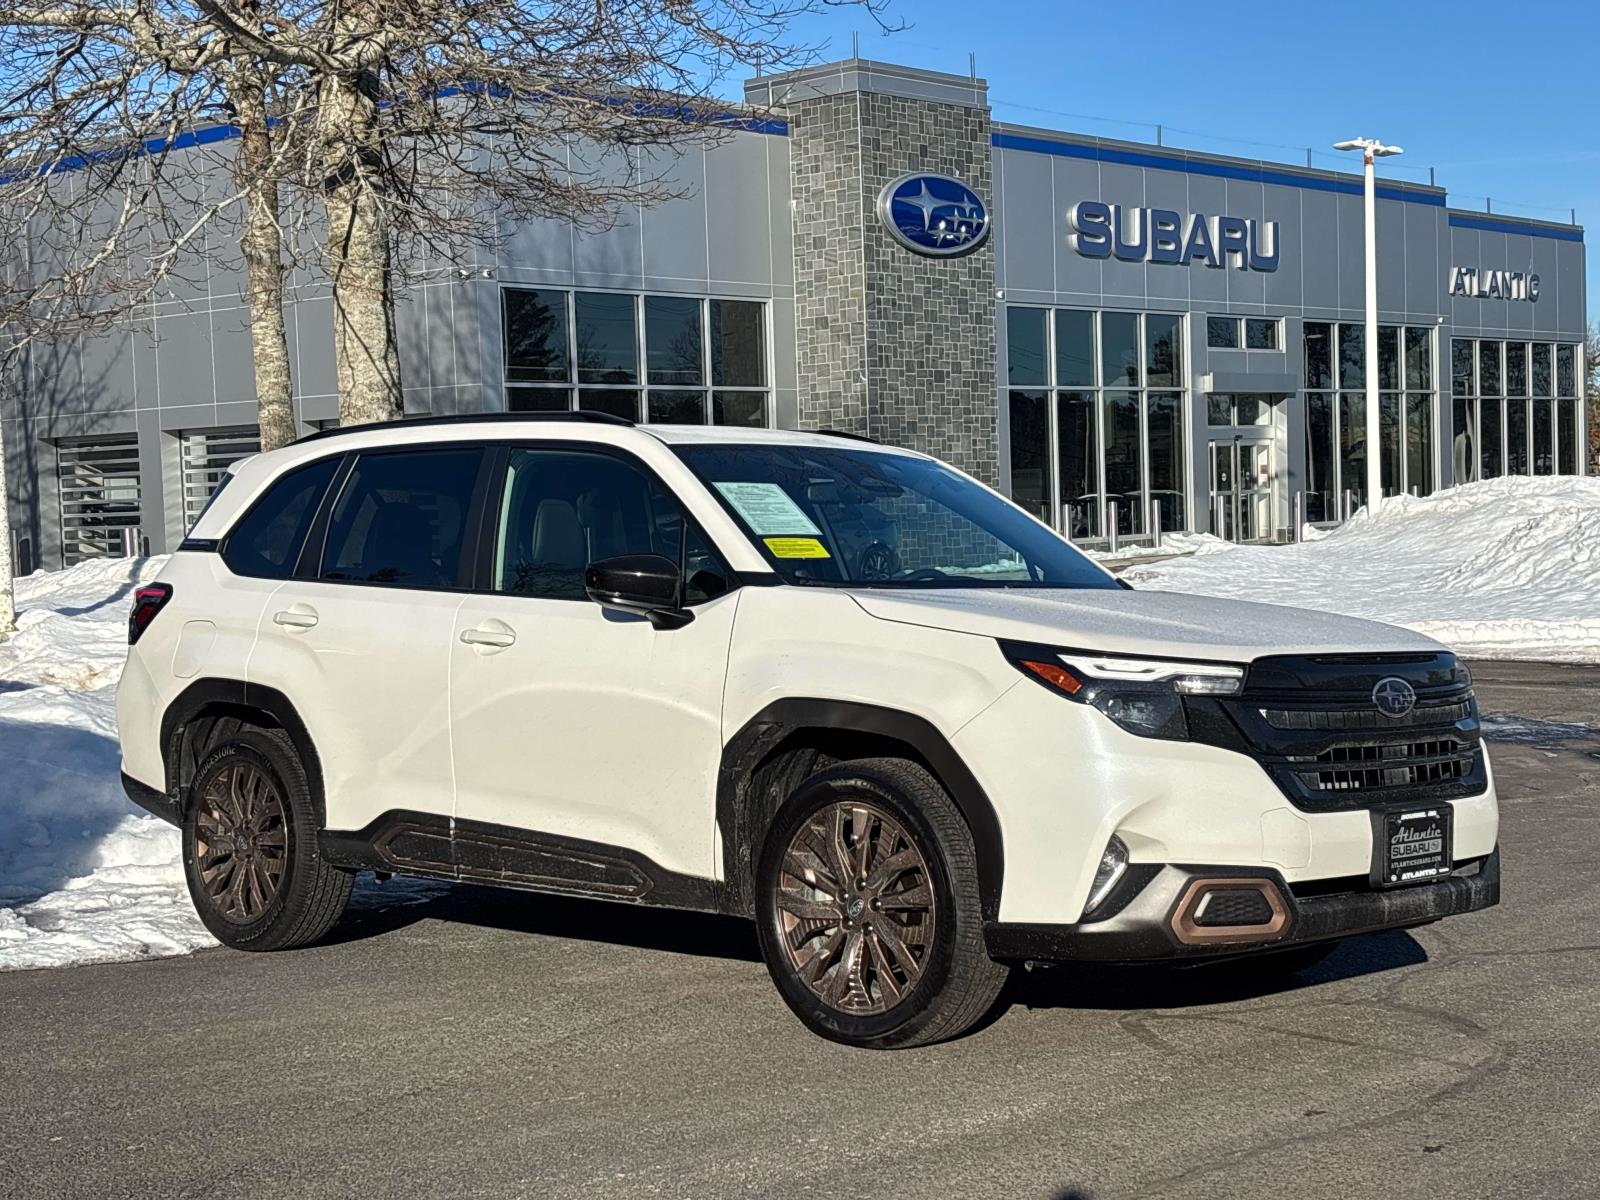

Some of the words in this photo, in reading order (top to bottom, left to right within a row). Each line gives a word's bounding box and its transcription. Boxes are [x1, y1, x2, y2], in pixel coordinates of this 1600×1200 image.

[1069, 200, 1280, 273] SUBARU
[1448, 266, 1541, 303] ATLANTIC
[1391, 823, 1443, 844] Atlantic
[1392, 843, 1430, 857] SUBARU
[1401, 868, 1438, 880] ATLANTIC
